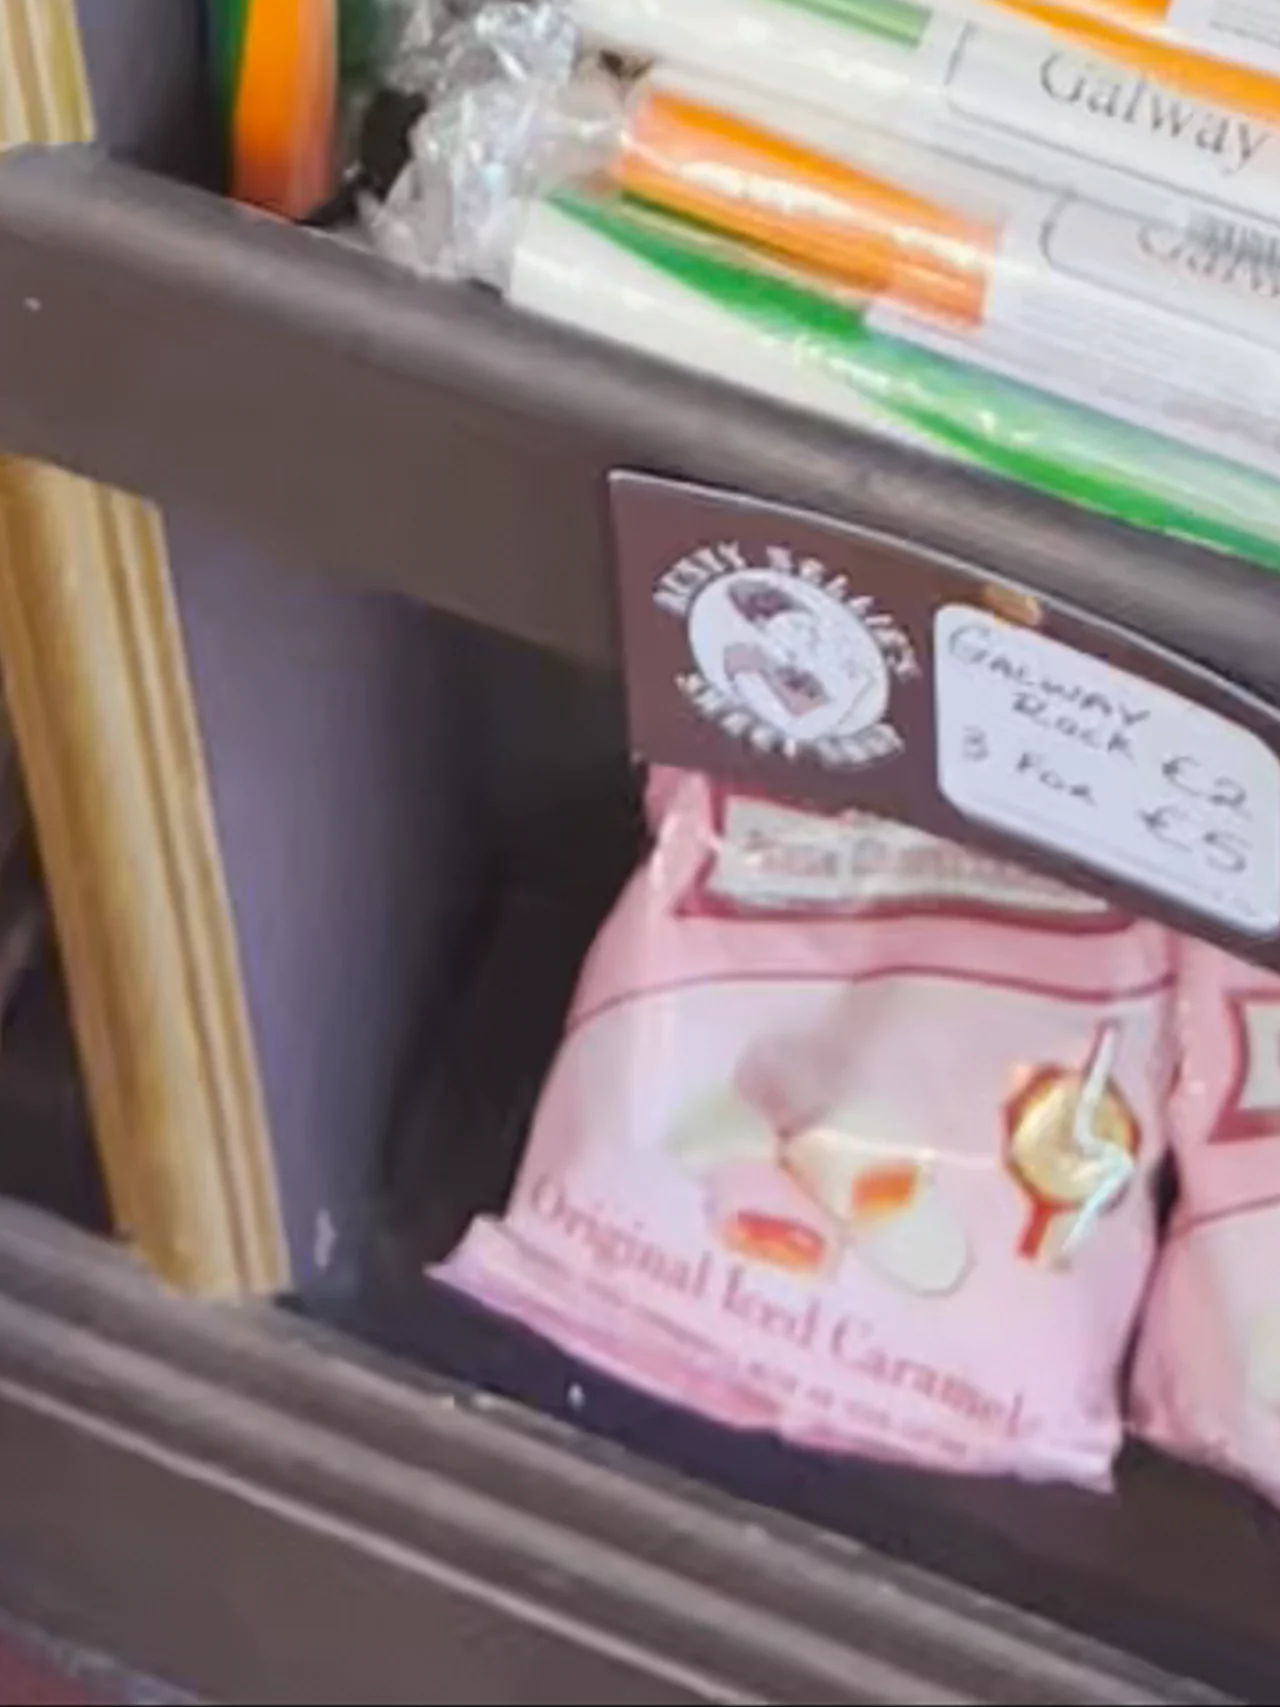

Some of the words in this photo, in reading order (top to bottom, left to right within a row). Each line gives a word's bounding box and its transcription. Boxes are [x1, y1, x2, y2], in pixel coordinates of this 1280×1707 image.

[1039, 50, 1274, 177] Galway
[948, 624, 1151, 727] GALWAY
[1012, 691, 1136, 766] ROCK
[1017, 750, 1099, 809] FOR
[528, 1174, 714, 1300] Original
[724, 1259, 819, 1347] Iced
